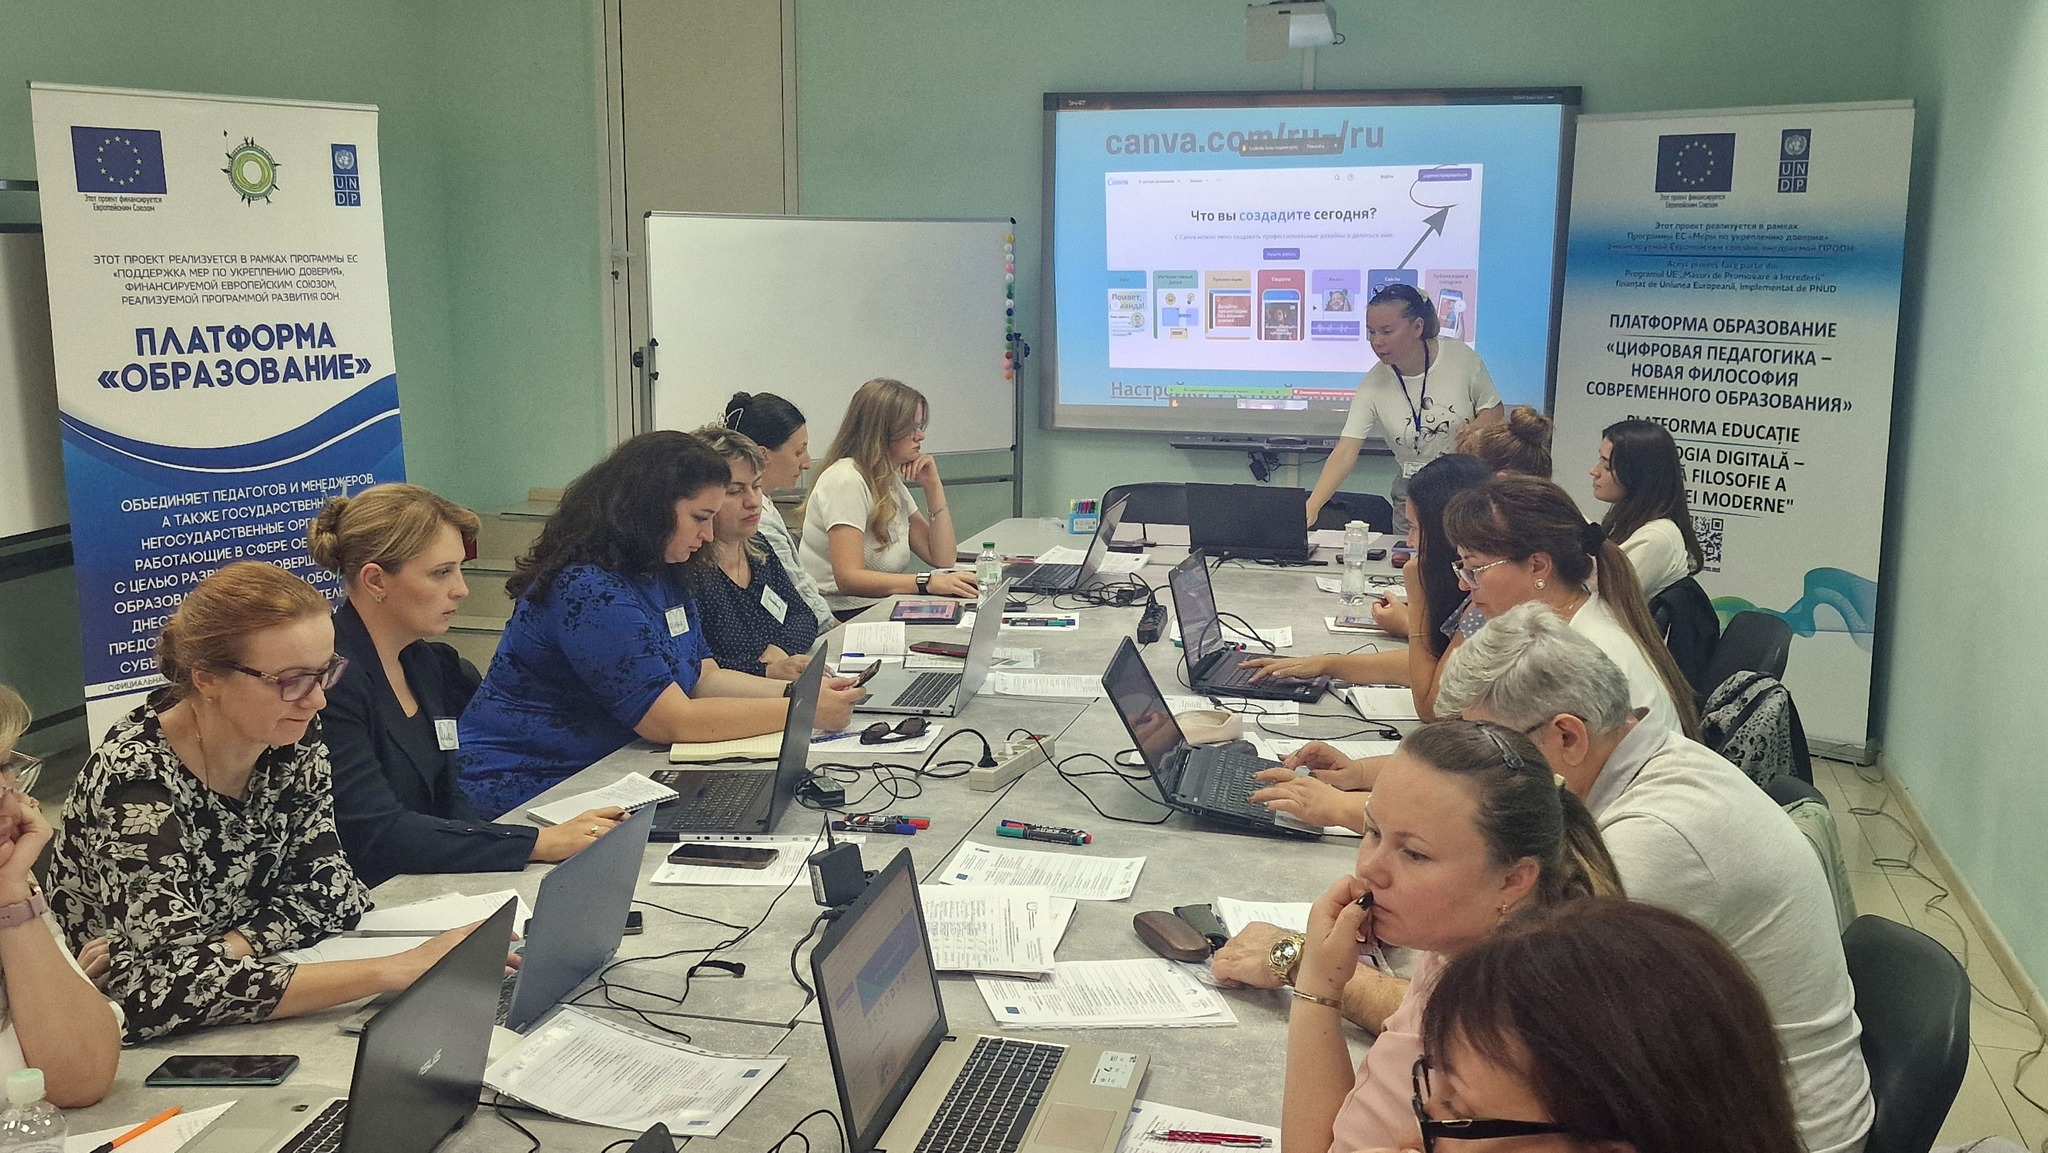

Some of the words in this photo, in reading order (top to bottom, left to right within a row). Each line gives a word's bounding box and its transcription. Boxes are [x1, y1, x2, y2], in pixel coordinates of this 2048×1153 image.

[1190, 209, 1215, 222] Что
[1218, 211, 1237, 222] вы
[1239, 209, 1311, 223] создадите
[1313, 207, 1378, 223] сегодня?
[1655, 221, 1673, 230] Этот
[1675, 223, 1704, 231] проект
[1705, 223, 1757, 232] реализуется
[1766, 223, 1798, 231] рамках
[1627, 231, 1674, 242] Программы
[1675, 232, 1687, 240] ЕС
[1731, 234, 1784, 242] укреплению
[93, 254, 121, 265] ЭТОТ
[124, 254, 166, 265] ПРОЕКТ
[168, 254, 238, 264] РЕАЛИЗУЕТСЯ
[240, 254, 248, 264] В
[250, 254, 288, 264] РАМКАХ
[289, 254, 345, 264] ПРОГРАММЫ
[347, 254, 359, 264] ЕС
[113, 267, 187, 279] «ПОДДЕРЖКА
[189, 267, 210, 278] МЕР
[212, 267, 227, 277] ПО
[230, 267, 296, 277] УКРЕПЛЕНИЮ
[298, 267, 345, 278] ДОВЕРИЯ»,
[1624, 270, 1665, 279] Programul
[1666, 270, 1678, 279] UE
[1724, 271, 1774, 281] Promovare
[124, 280, 219, 291] ФИНАНСИРУЕМОЙ
[221, 279, 293, 290] ЕВРОПЕЙСКИМ
[295, 279, 337, 290] СОЮЗОМ,
[1648, 280, 1658, 288] de
[1659, 280, 1691, 289] Uniunea
[1739, 283, 1794, 292] implementat
[1796, 284, 1807, 292] de
[1809, 285, 1837, 293] PNUD
[121, 293, 199, 305] РЕАЛИЗУЕМОЙ
[201, 292, 269, 303] ПРОГРАММОЙ
[271, 292, 318, 302] РАЗВИТИЯ
[320, 292, 342, 301] ООН.
[1609, 313, 1709, 333] ПЛАТФОРМА
[1712, 316, 1838, 339] ОБРАЗОВАНИЕ
[134, 321, 337, 357] ПЛАТФОРМА
[1606, 340, 1703, 362] «ЦИФРОВАЯ
[1706, 345, 1817, 367] ПЕДАГОГИКА
[96, 353, 373, 393] «ОБРАЗОВАНИЕ»
[1630, 362, 1684, 381] НОВАЯ
[1688, 366, 1799, 388] ФИЛОСОФИЯ
[1585, 380, 1711, 404] СОВРЕМЕННОГО
[1714, 390, 1853, 414] ОБРАЗОВАНИЯ»
[1722, 422, 1801, 445] EDUCAȚIE
[1716, 449, 1790, 471] DIGITALĂ
[1692, 468, 1771, 491] FILOSOFIE
[1774, 477, 1788, 493] A
[120, 491, 210, 512] ОБЪЕДИНЯЕТ
[212, 483, 287, 502] ПЕДАГОГОВ
[289, 481, 299, 494] И
[301, 473, 376, 493] МЕНЕДЖЕРОВ,
[1702, 491, 1795, 514] MODERNE"
[161, 516, 172, 528] А
[173, 510, 220, 526] ТАКЖЕ
[222, 497, 325, 520] ГОСУДАРСТВЕНН
[141, 521, 285, 550] НЕГОСУДАРСТВЕННЫЕ
[134, 547, 233, 571] РАБОТАЮЩИЕ
[234, 546, 244, 558] В
[246, 540, 288, 555] СФЕРЕ
[114, 581, 127, 594] С
[129, 574, 179, 593] ЦЕЛЬЮ
